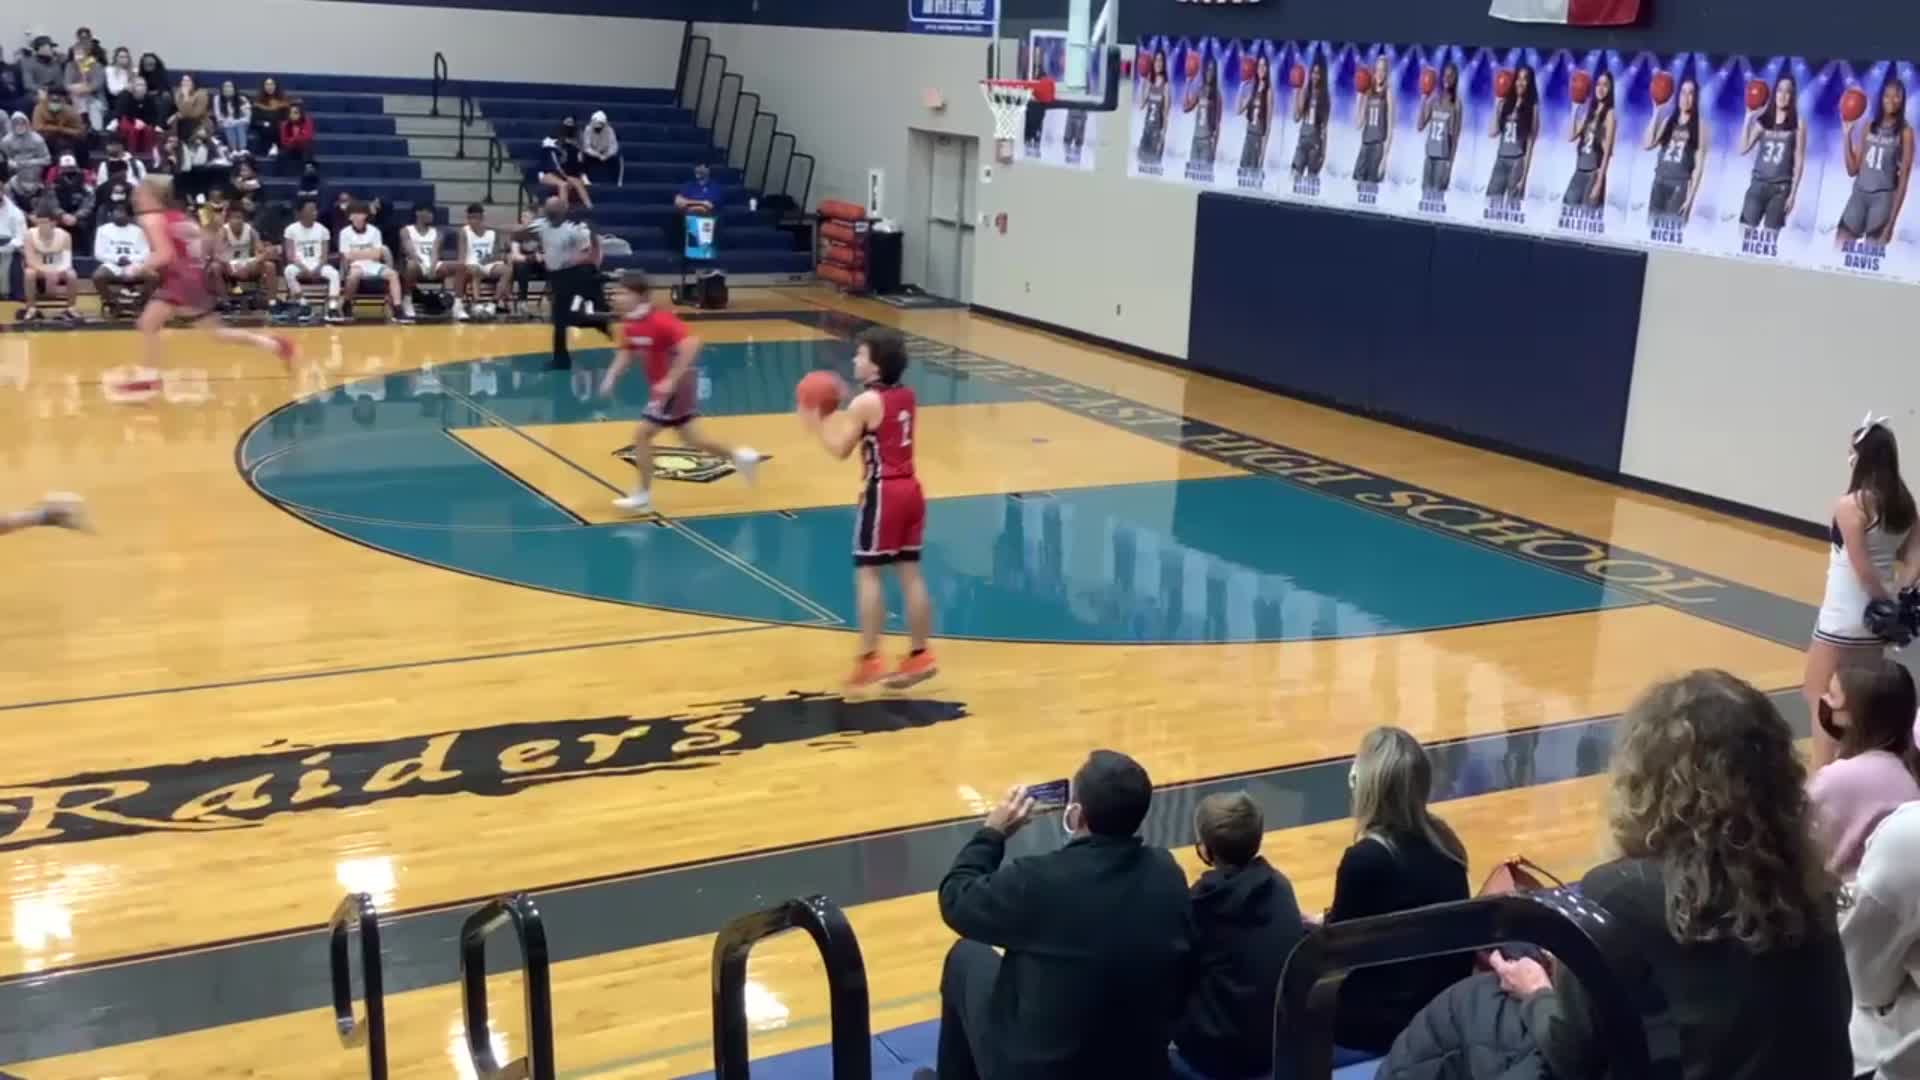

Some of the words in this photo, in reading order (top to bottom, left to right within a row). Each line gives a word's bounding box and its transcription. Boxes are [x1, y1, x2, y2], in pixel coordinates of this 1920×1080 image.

[1663, 139, 1686, 163] 23
[1763, 141, 1785, 164] 33
[1865, 145, 1884, 170] 41
[1742, 241, 1778, 257] HICKS
[1844, 253, 1880, 271] DAVIS
[1166, 432, 1374, 485] HIGH
[1354, 490, 1728, 603] SCHOOL
[0, 712, 745, 842] Raiders
